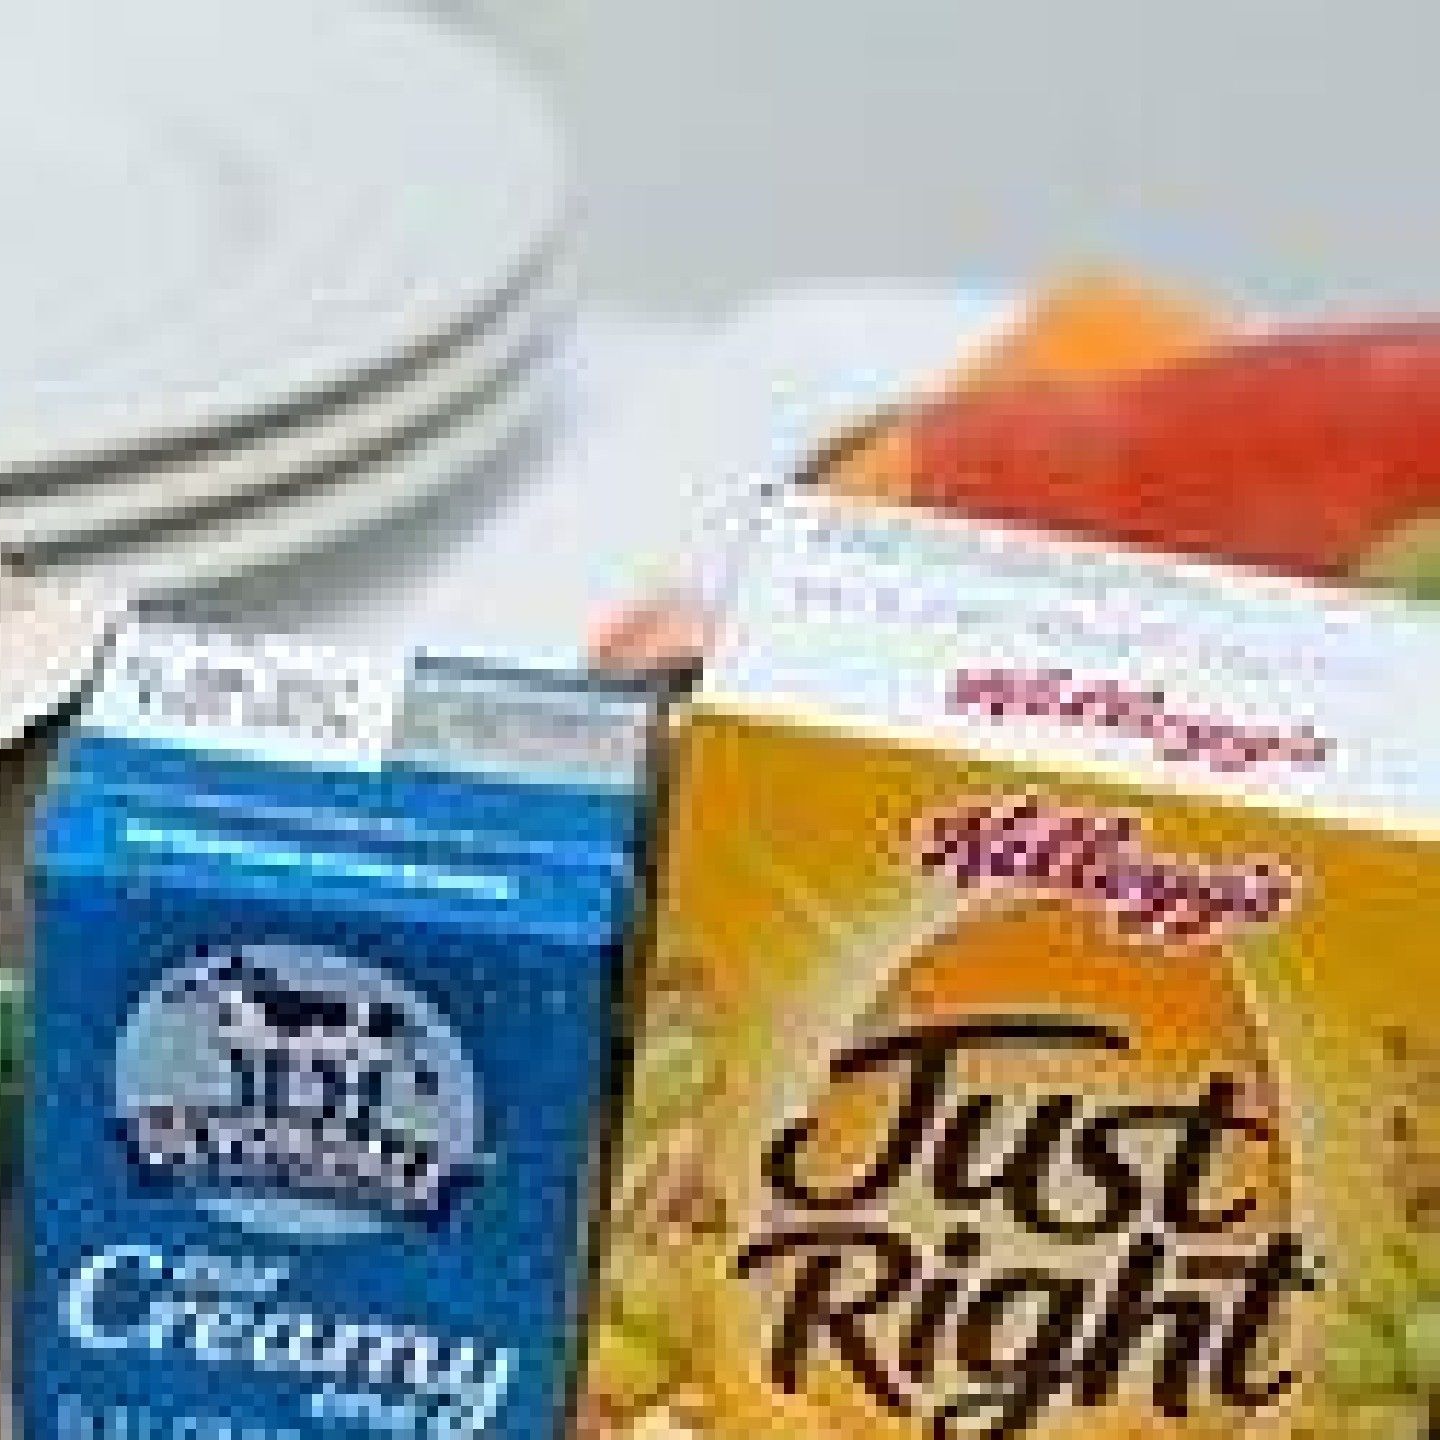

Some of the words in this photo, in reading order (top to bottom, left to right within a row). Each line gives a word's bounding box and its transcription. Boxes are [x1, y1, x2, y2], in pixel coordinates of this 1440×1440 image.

[949, 666, 1337, 775] Kellogg's
[910, 798, 1302, 942] Kellogg's
[758, 1012, 1276, 1242] Just
